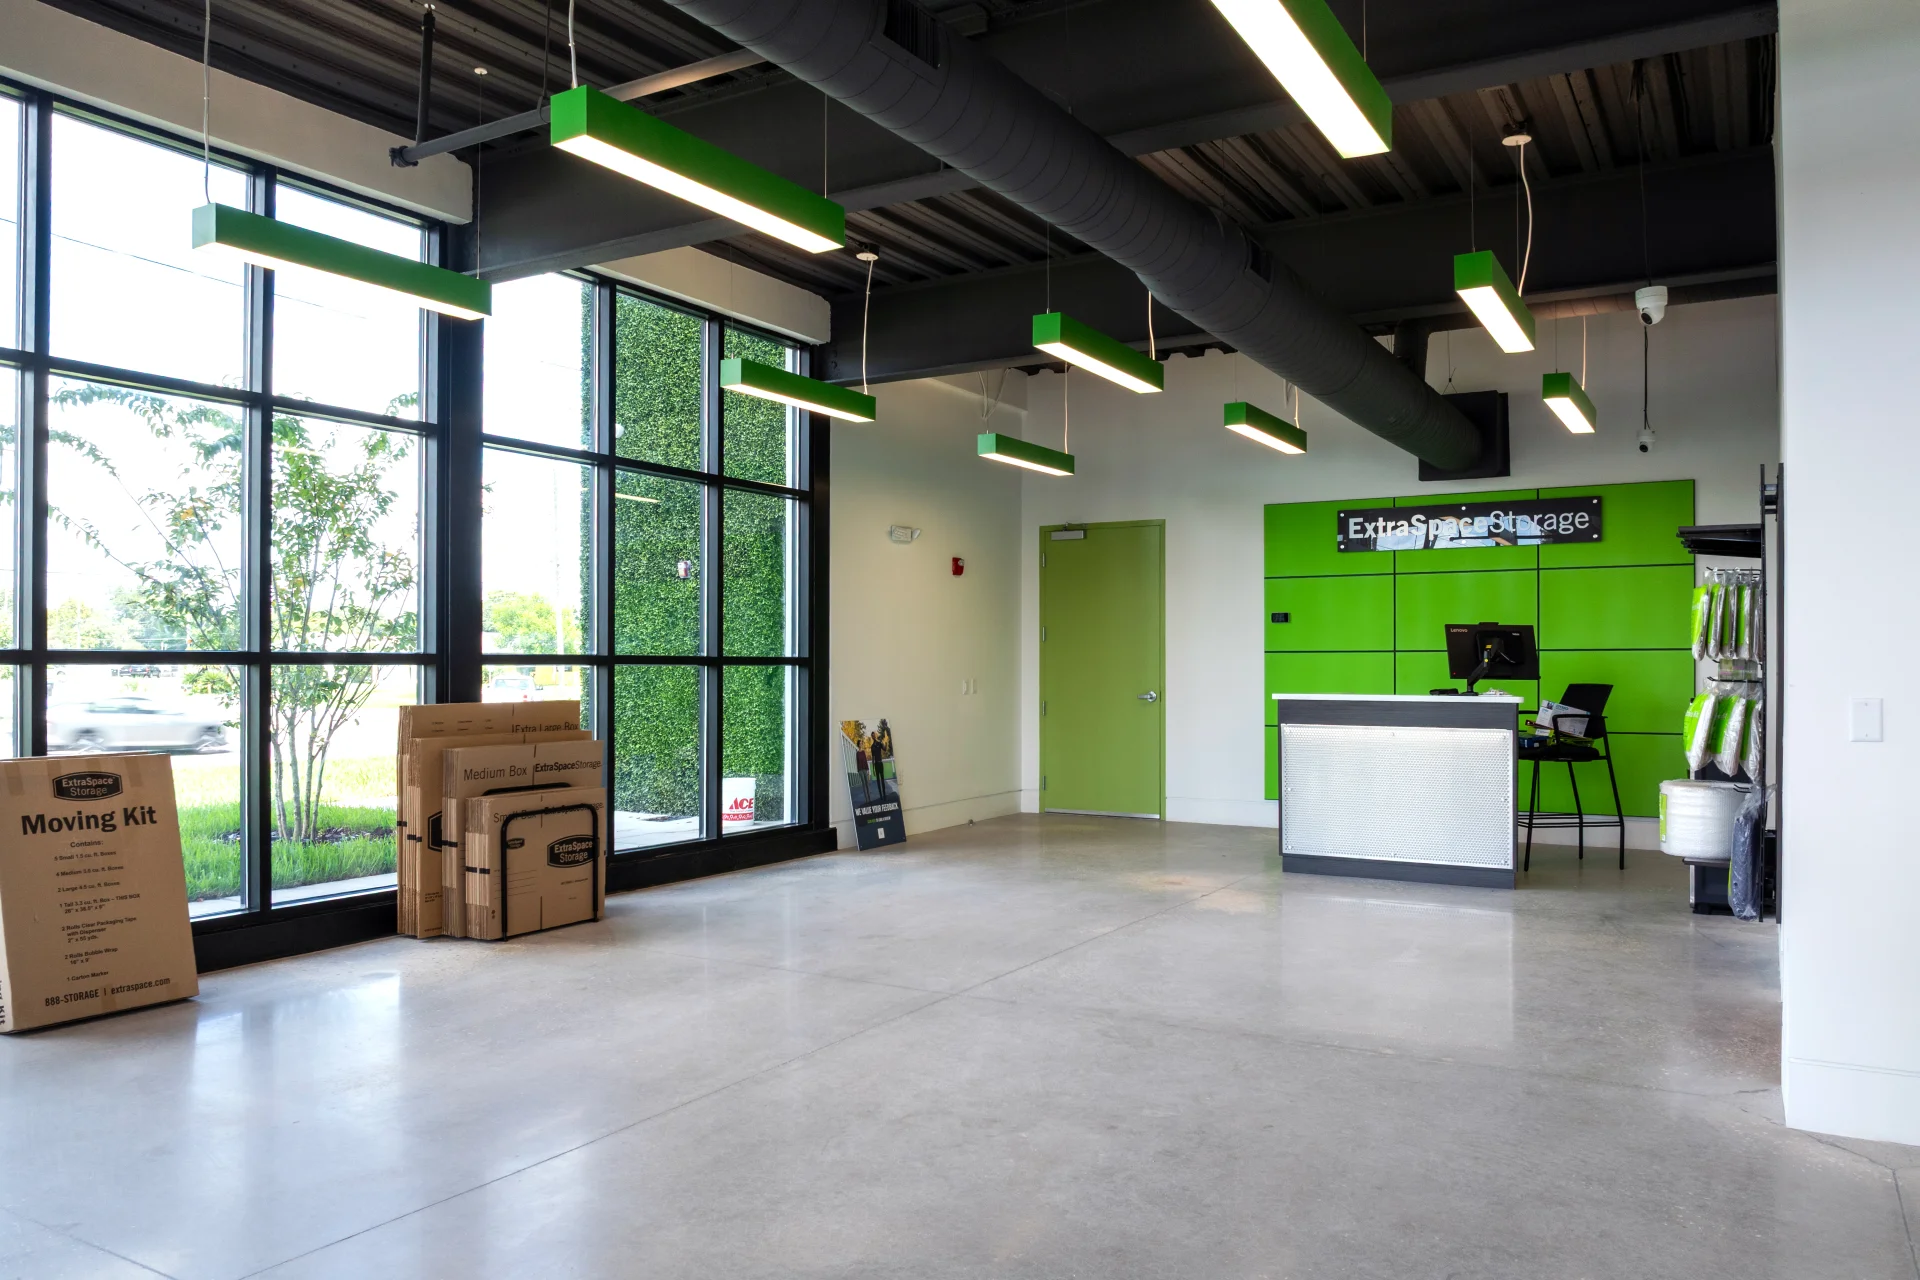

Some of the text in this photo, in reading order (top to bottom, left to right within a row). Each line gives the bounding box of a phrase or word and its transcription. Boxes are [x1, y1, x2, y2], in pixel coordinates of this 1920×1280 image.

[1348, 510, 1590, 540] ExtraSpaceStorage
[564, 722, 578, 730] Box
[463, 765, 528, 781] Medium Box
[62, 777, 114, 787] ExtraSpace
[70, 787, 108, 797] Storage
[729, 797, 754, 810] ACE
[21, 806, 158, 836] Moving Kit
[494, 810, 518, 823] Smll
[70, 840, 104, 848] Contains:
[554, 840, 593, 853] ExtraSpace
[560, 852, 588, 863] Storage
[45, 988, 100, 1006] 888-STORAGE
[111, 977, 171, 995] extraspace.com
